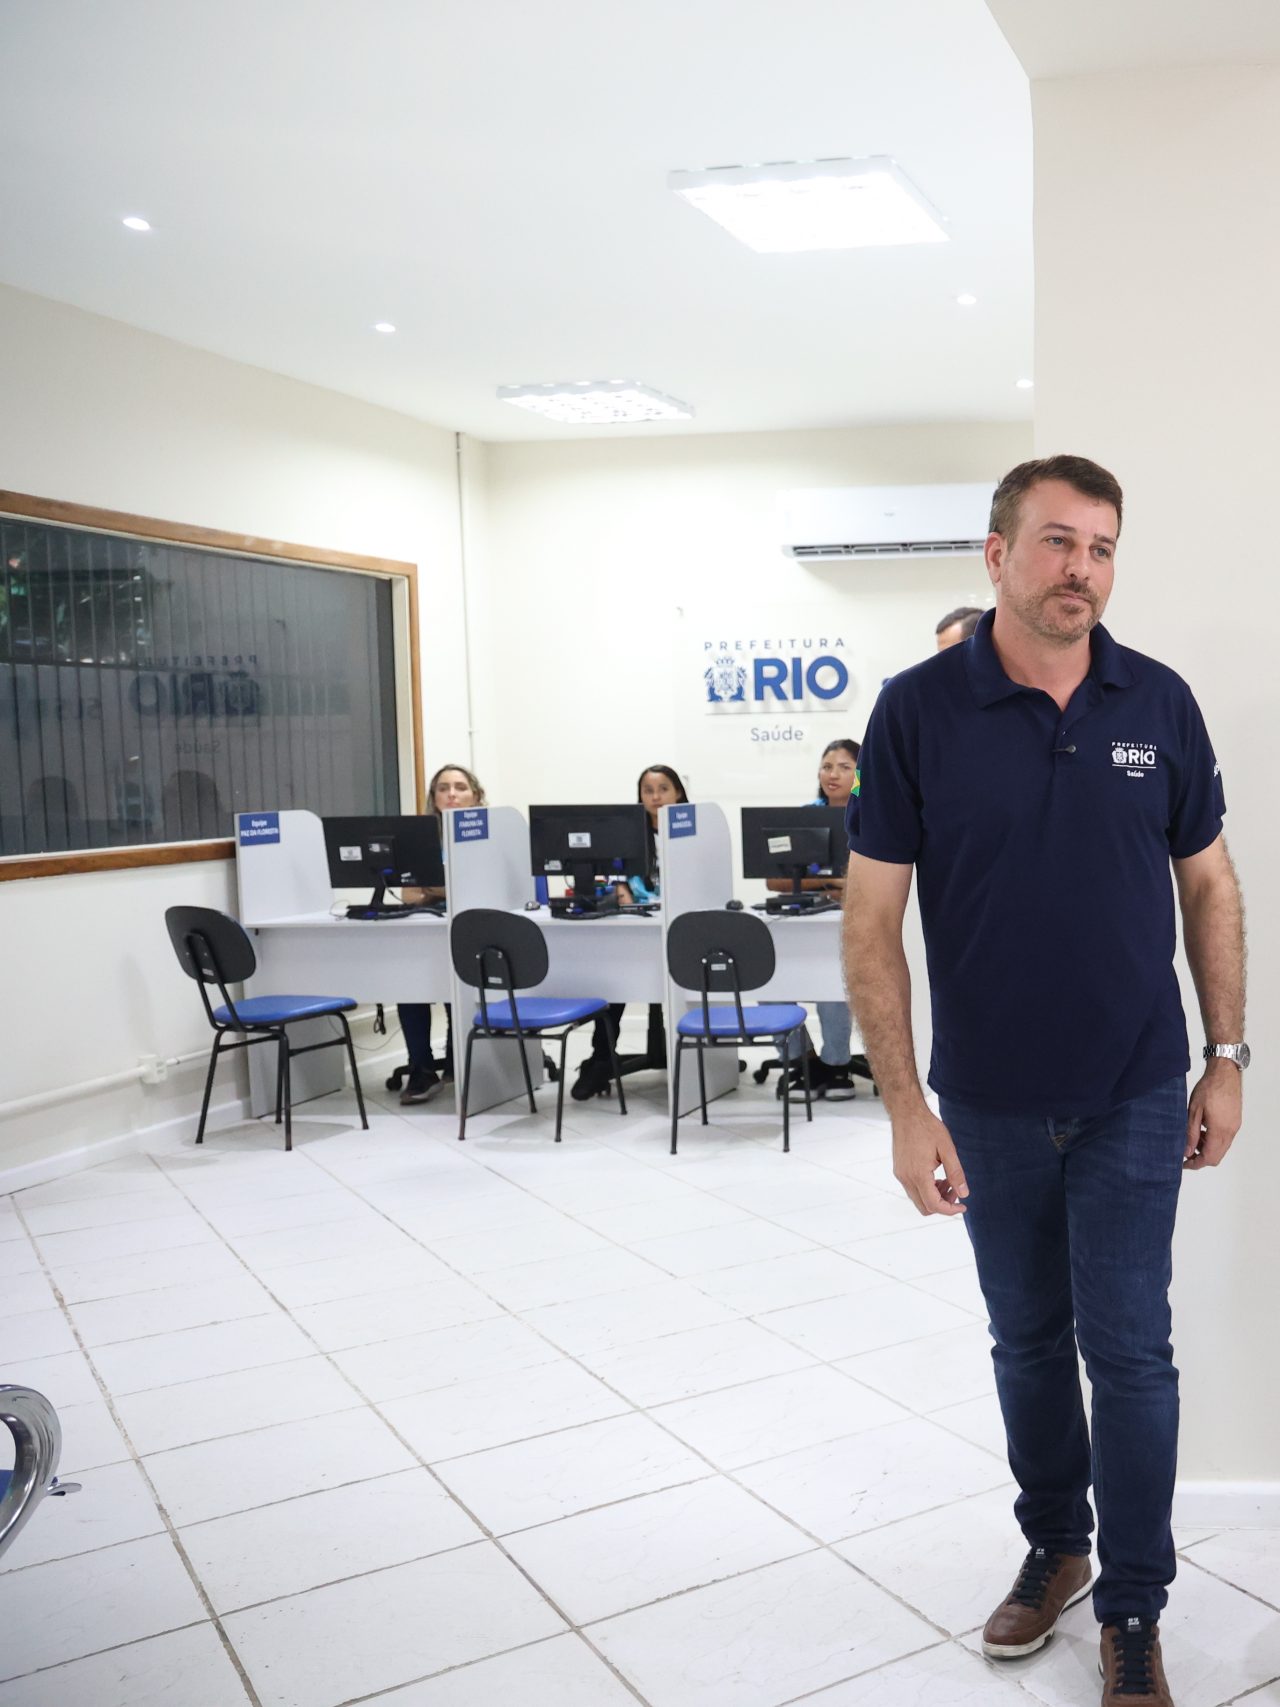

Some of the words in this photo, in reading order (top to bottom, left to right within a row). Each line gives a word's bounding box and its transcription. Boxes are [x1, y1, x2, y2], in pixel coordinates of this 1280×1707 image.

[704, 637, 845, 651] PREFEITURA
[753, 655, 849, 701] RIO
[750, 724, 804, 742] Saúde
[1111, 741, 1157, 751] PREFEITURA
[1128, 749, 1155, 765] RIO
